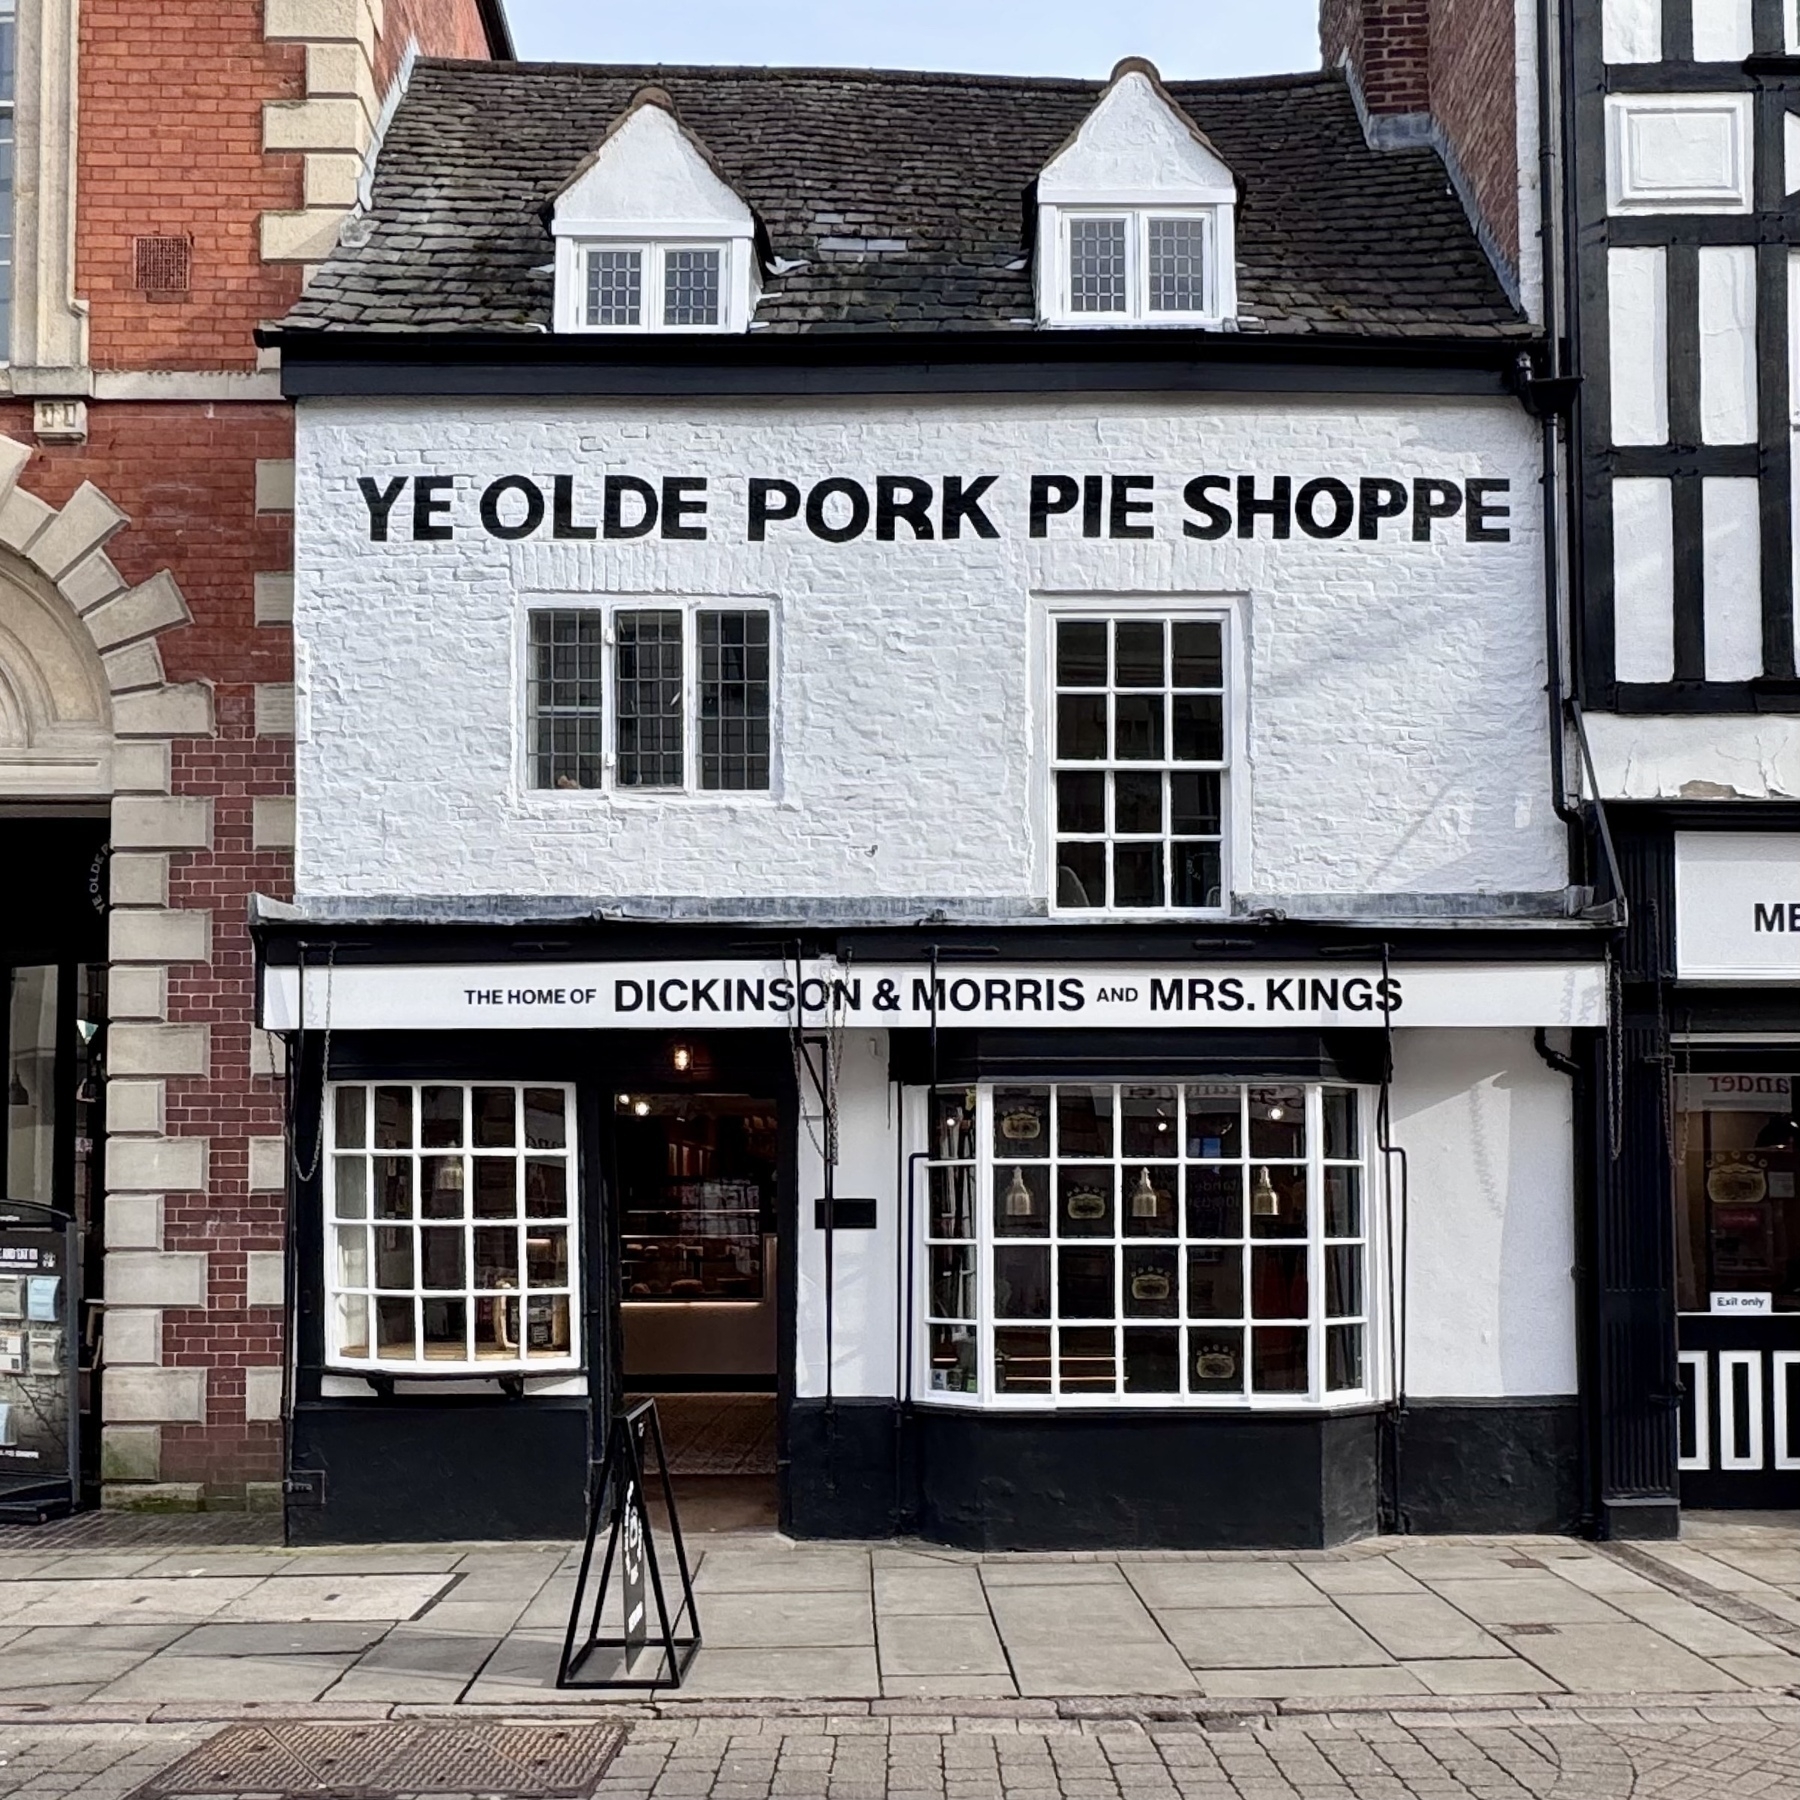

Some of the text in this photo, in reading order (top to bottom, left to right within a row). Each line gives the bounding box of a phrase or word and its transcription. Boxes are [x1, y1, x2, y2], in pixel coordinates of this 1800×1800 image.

[359, 475, 1510, 543] YE OLDE PORK PIE SHOPPE
[464, 978, 1403, 1012] THE HOME OF DICKINSON & MORRIS AND MRS. KINGS
[1717, 1297, 1764, 1309] Exit only
